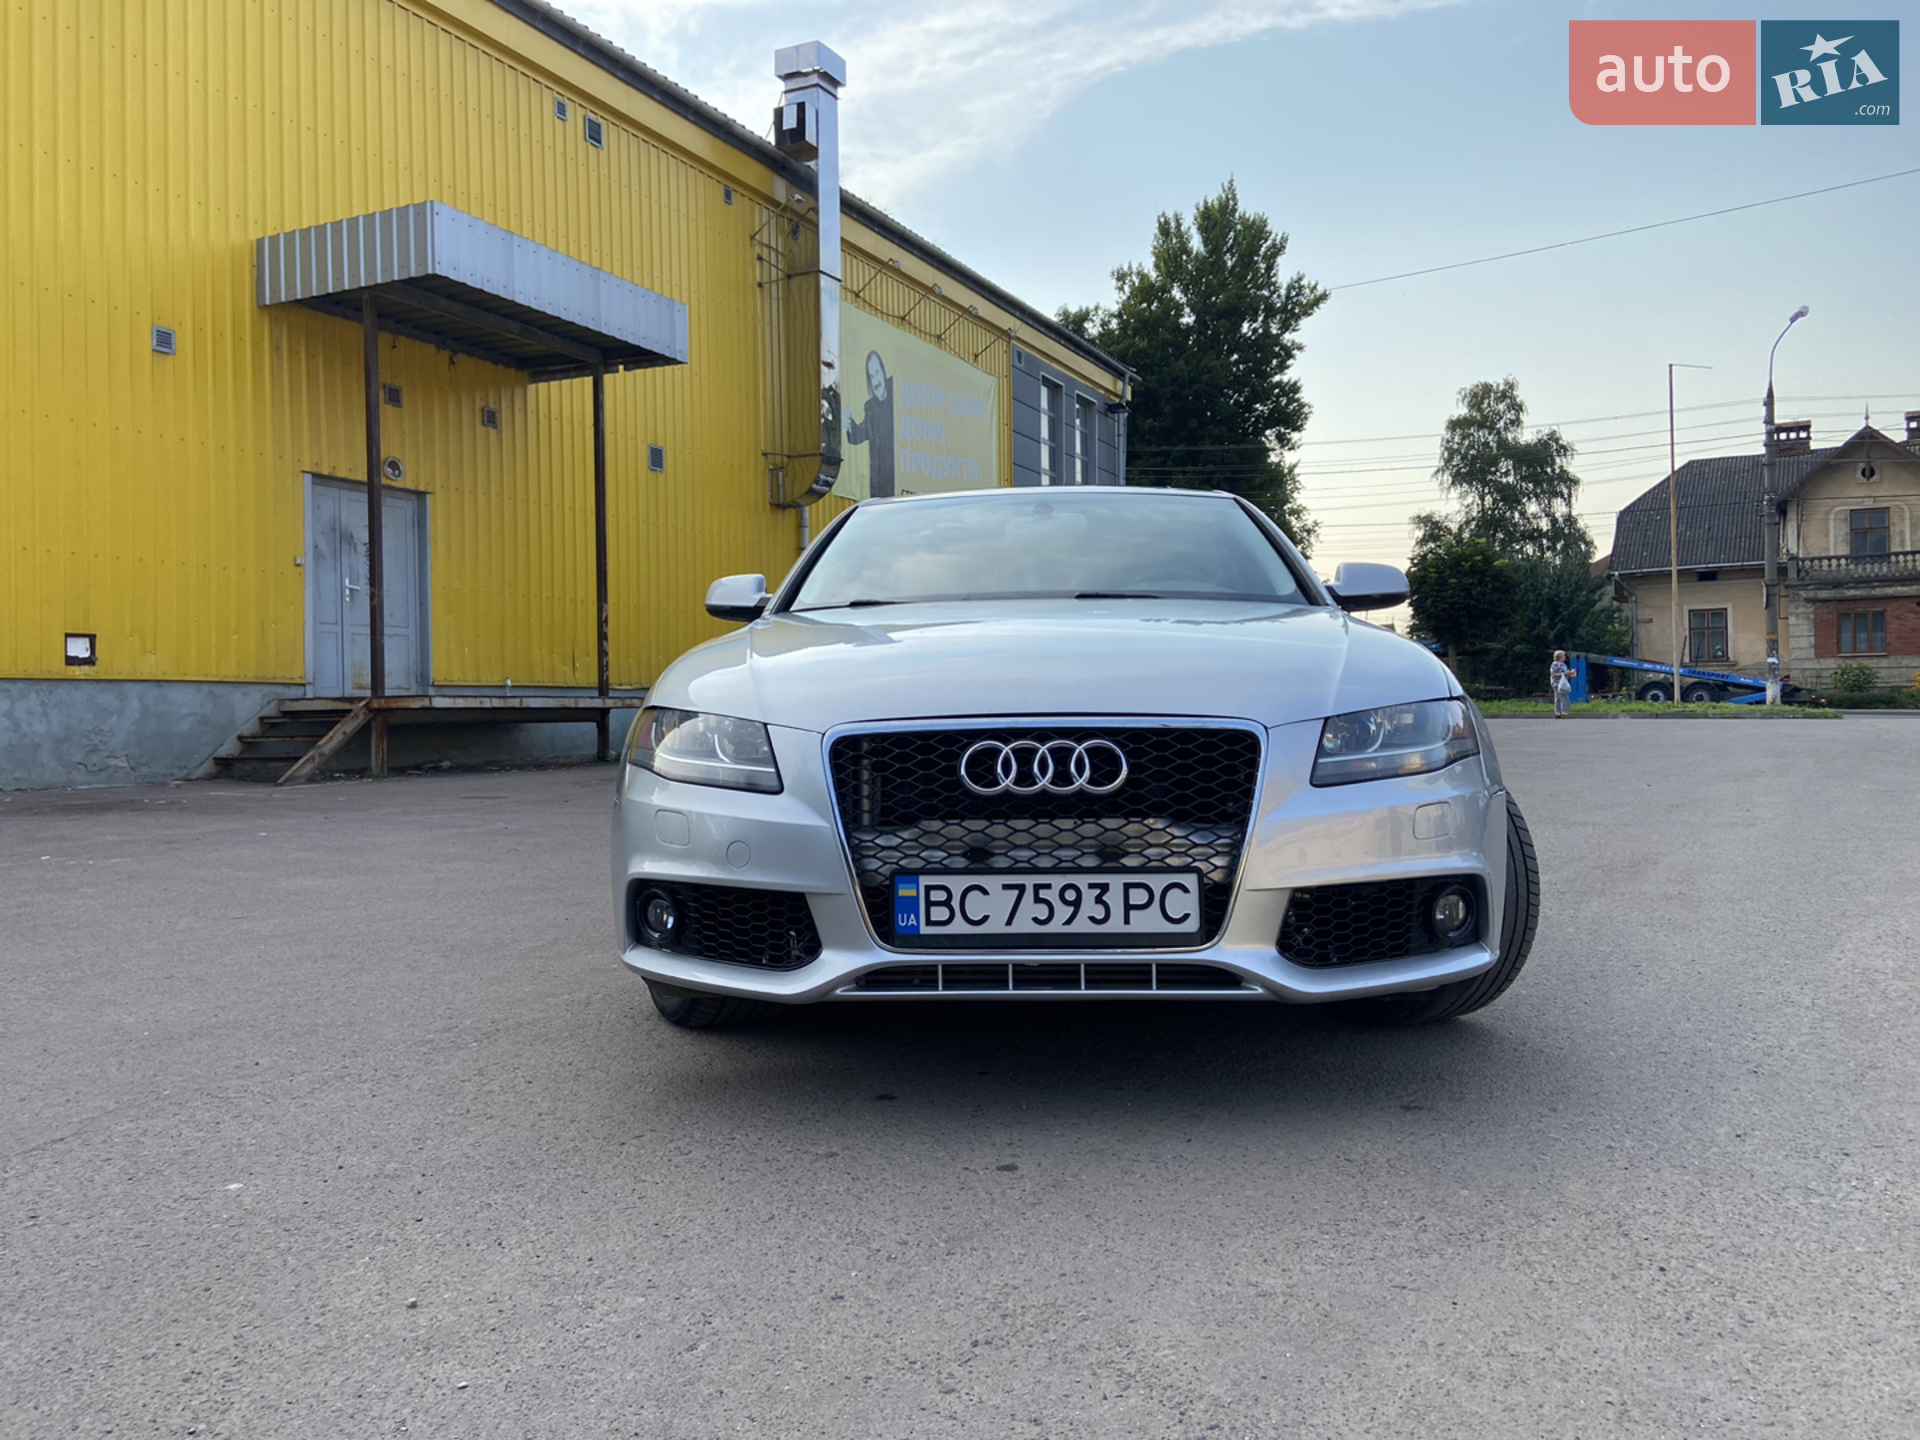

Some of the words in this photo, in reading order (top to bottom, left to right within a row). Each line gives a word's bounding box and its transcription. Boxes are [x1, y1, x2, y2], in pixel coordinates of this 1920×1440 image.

[899, 379, 947, 411] ДОБРІ
[899, 414, 947, 445] ДОБРІ
[1687, 668, 1730, 680] TRANSPORT
[898, 913, 918, 926] UA
